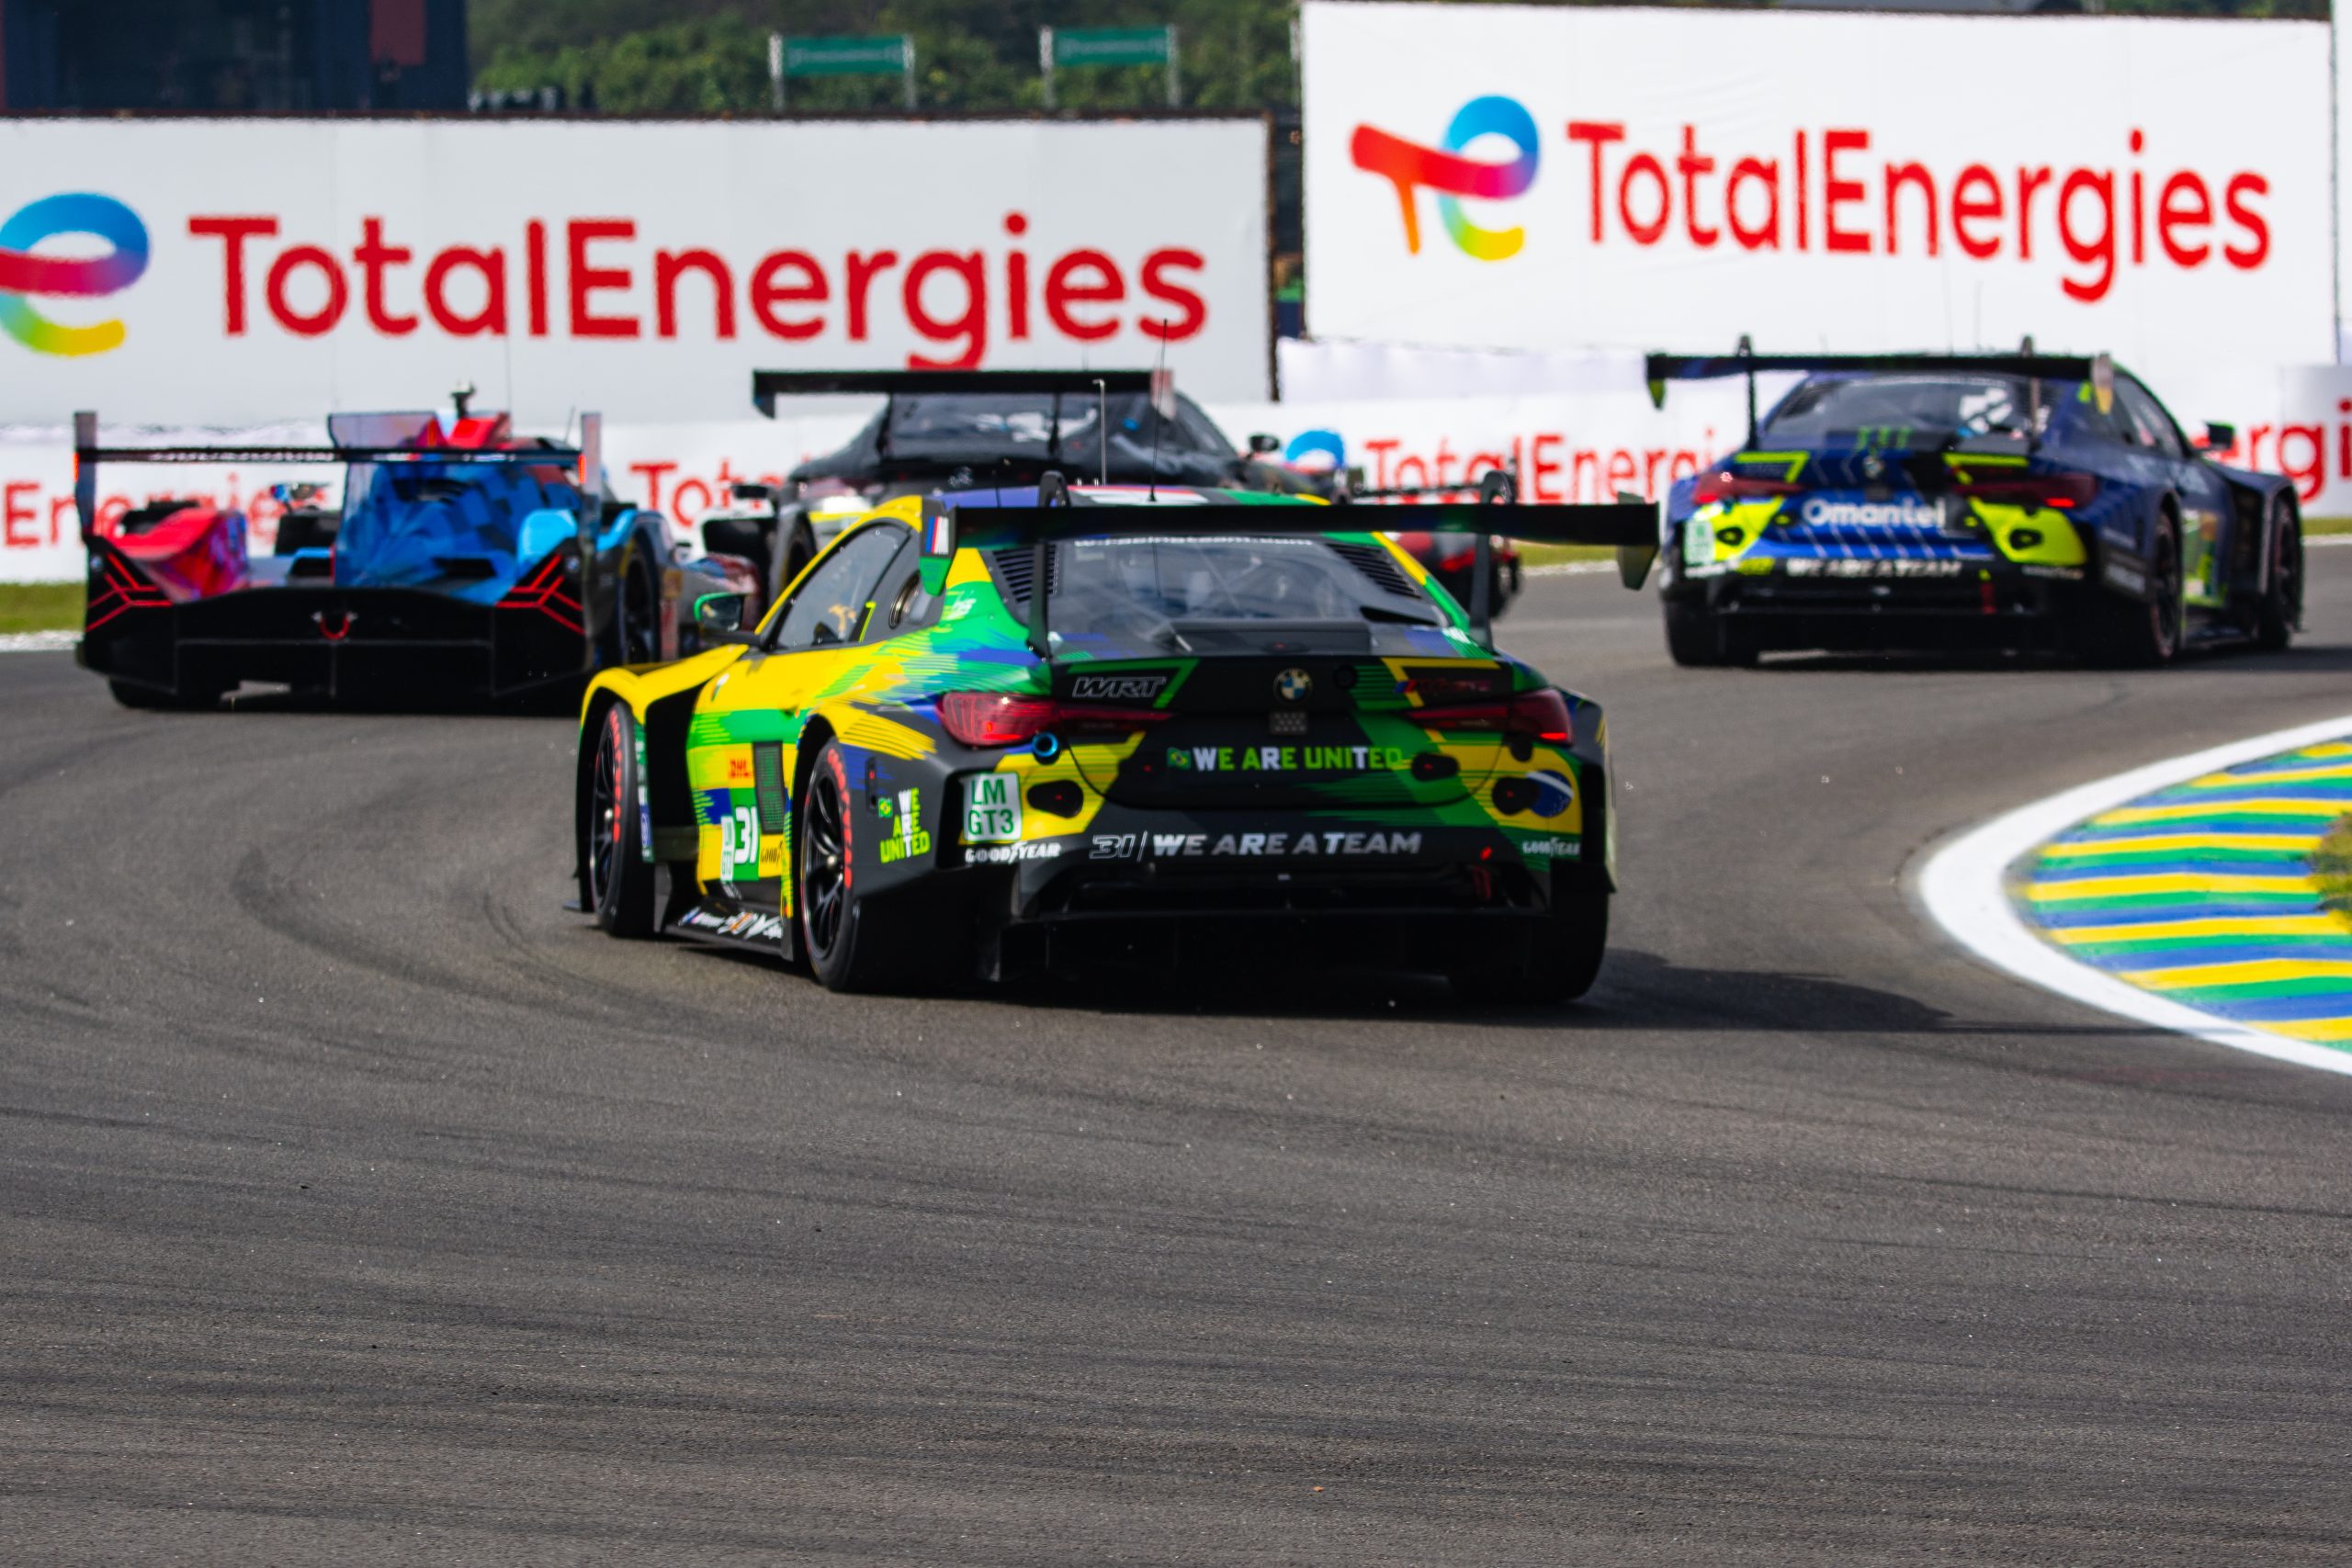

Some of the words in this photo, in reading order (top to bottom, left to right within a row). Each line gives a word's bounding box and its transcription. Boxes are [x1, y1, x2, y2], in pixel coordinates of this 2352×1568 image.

[1566, 120, 2271, 303] TotalEnergies
[188, 212, 1208, 370] TotalEnergies
[1802, 496, 1947, 528] Omantel
[1072, 676, 1168, 698] WRT
[1193, 747, 1235, 771] WE
[1242, 747, 1296, 770] ARE
[1304, 747, 1403, 770] UNITED
[898, 787, 921, 814] WE
[971, 778, 1007, 805] LM
[734, 807, 758, 863] 31
[967, 807, 1015, 836] GT3
[879, 830, 932, 863] UNITED
[965, 841, 1062, 864] GOODYEAR
[1153, 834, 1207, 856] WE
[1211, 833, 1288, 855] ARE
[1292, 832, 1318, 854] A
[1323, 831, 1422, 854] TEAM
